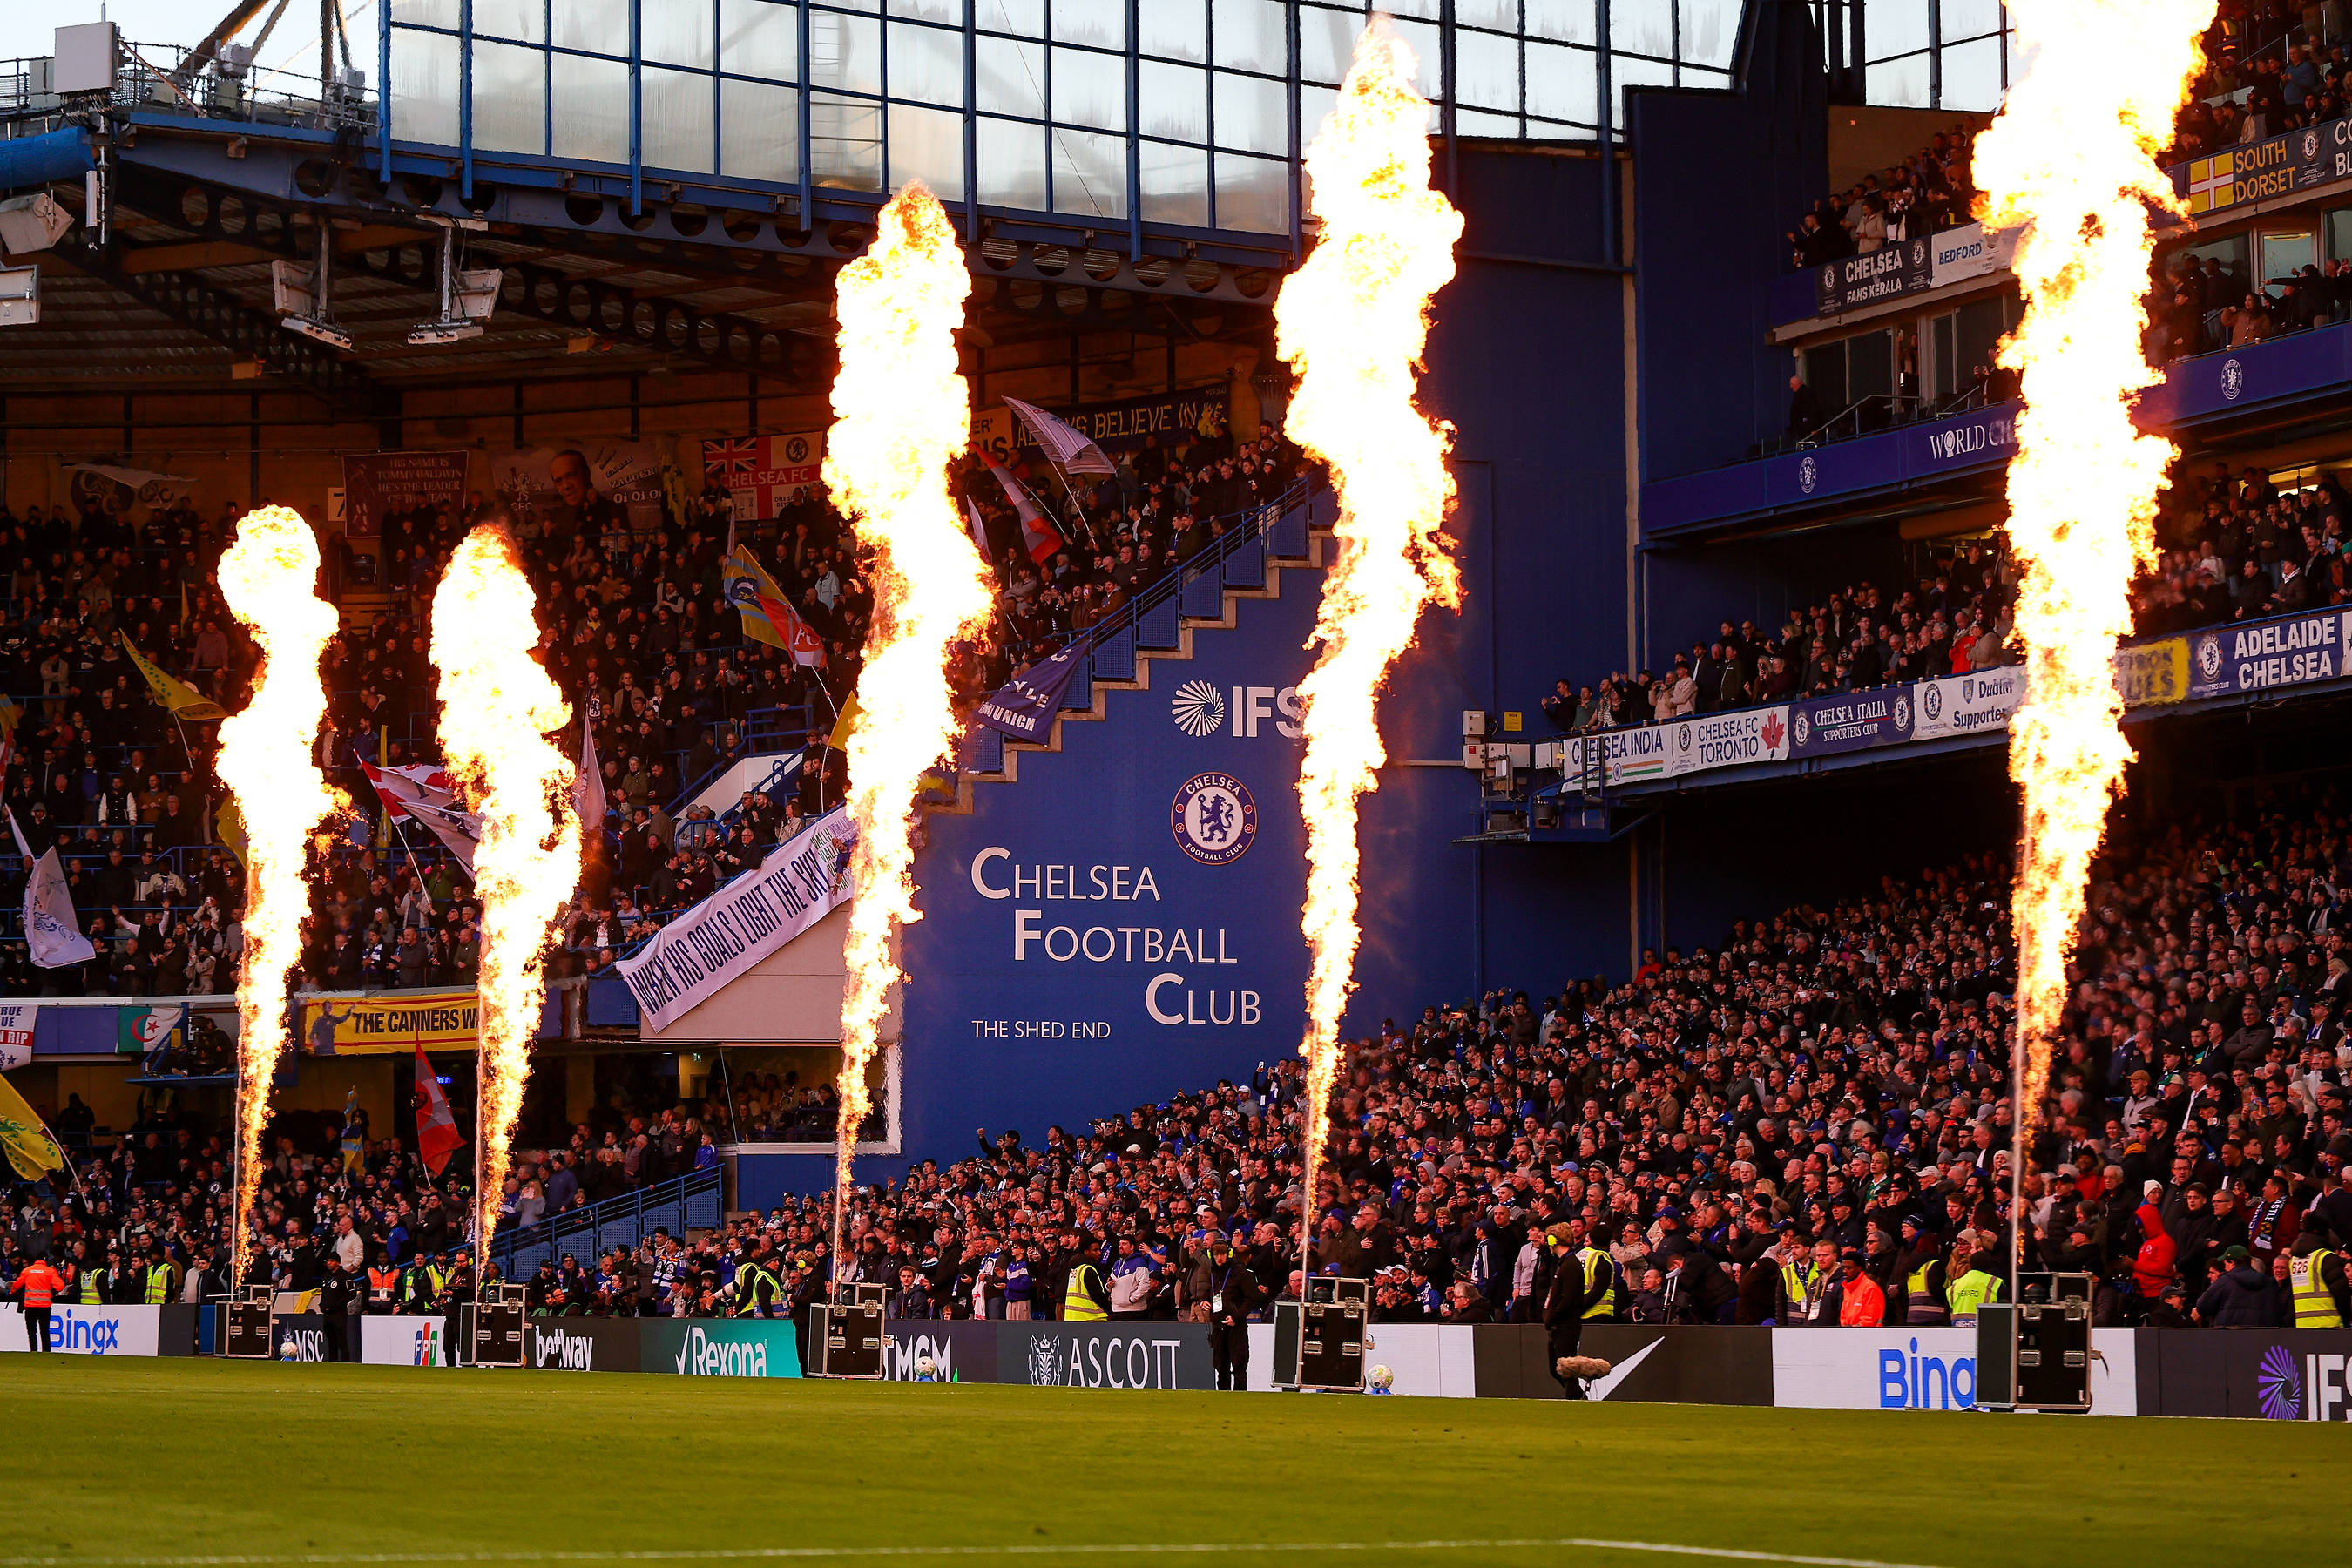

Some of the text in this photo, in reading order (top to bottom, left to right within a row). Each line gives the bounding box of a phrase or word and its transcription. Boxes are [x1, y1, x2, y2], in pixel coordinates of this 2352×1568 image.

[2235, 139, 2287, 174] SOUTH
[2235, 166, 2296, 203] DORSET
[1845, 248, 1903, 284] CHELSEA
[1938, 241, 1983, 266] BEDFORD
[1846, 288, 1869, 305] FANS
[1869, 277, 1903, 299] KERALA
[1094, 404, 1172, 440] BELIEVE
[1179, 402, 1197, 429] IN
[1929, 424, 1986, 460] WORLD
[376, 468, 462, 481] TOMMY BALDWIN
[409, 457, 436, 468] NAME
[440, 457, 449, 467] IS
[377, 480, 461, 492] HE'S THE LEADER
[720, 468, 809, 489] CHELSEA FC
[404, 494, 416, 504] TH
[425, 493, 452, 503] TEAM
[2234, 616, 2336, 659] ADELAIDE
[2238, 651, 2333, 690] CHELSEA
[1978, 676, 2014, 699] Dublin
[1232, 686, 1302, 739] IFS
[1815, 700, 1888, 727] CHELSEA ITALIA
[1698, 716, 1759, 742] CHELSEA FC
[1823, 723, 1879, 742] SUPPORTERS CLUB
[1571, 728, 1664, 765] CELSEA INDIA
[1698, 735, 1759, 764] TORONTO
[1186, 775, 1241, 796] CHELSEA
[1186, 842, 1244, 860] FOOTBALL CLUB
[970, 846, 1161, 902] CHELSEA
[626, 848, 833, 1015] WHEN HIS GOALS LIGHT THE SKY
[1014, 909, 1239, 963] FOOTBALL
[1145, 972, 1261, 1025] CLUB
[353, 1012, 386, 1034] THE
[388, 1009, 459, 1033] CANNERS
[971, 1020, 1112, 1039] THE SHED END
[7, 1031, 29, 1044] RIP
[294, 1329, 324, 1362] MSC
[536, 1325, 593, 1372] betway
[1069, 1337, 1181, 1390] ASCOTT
